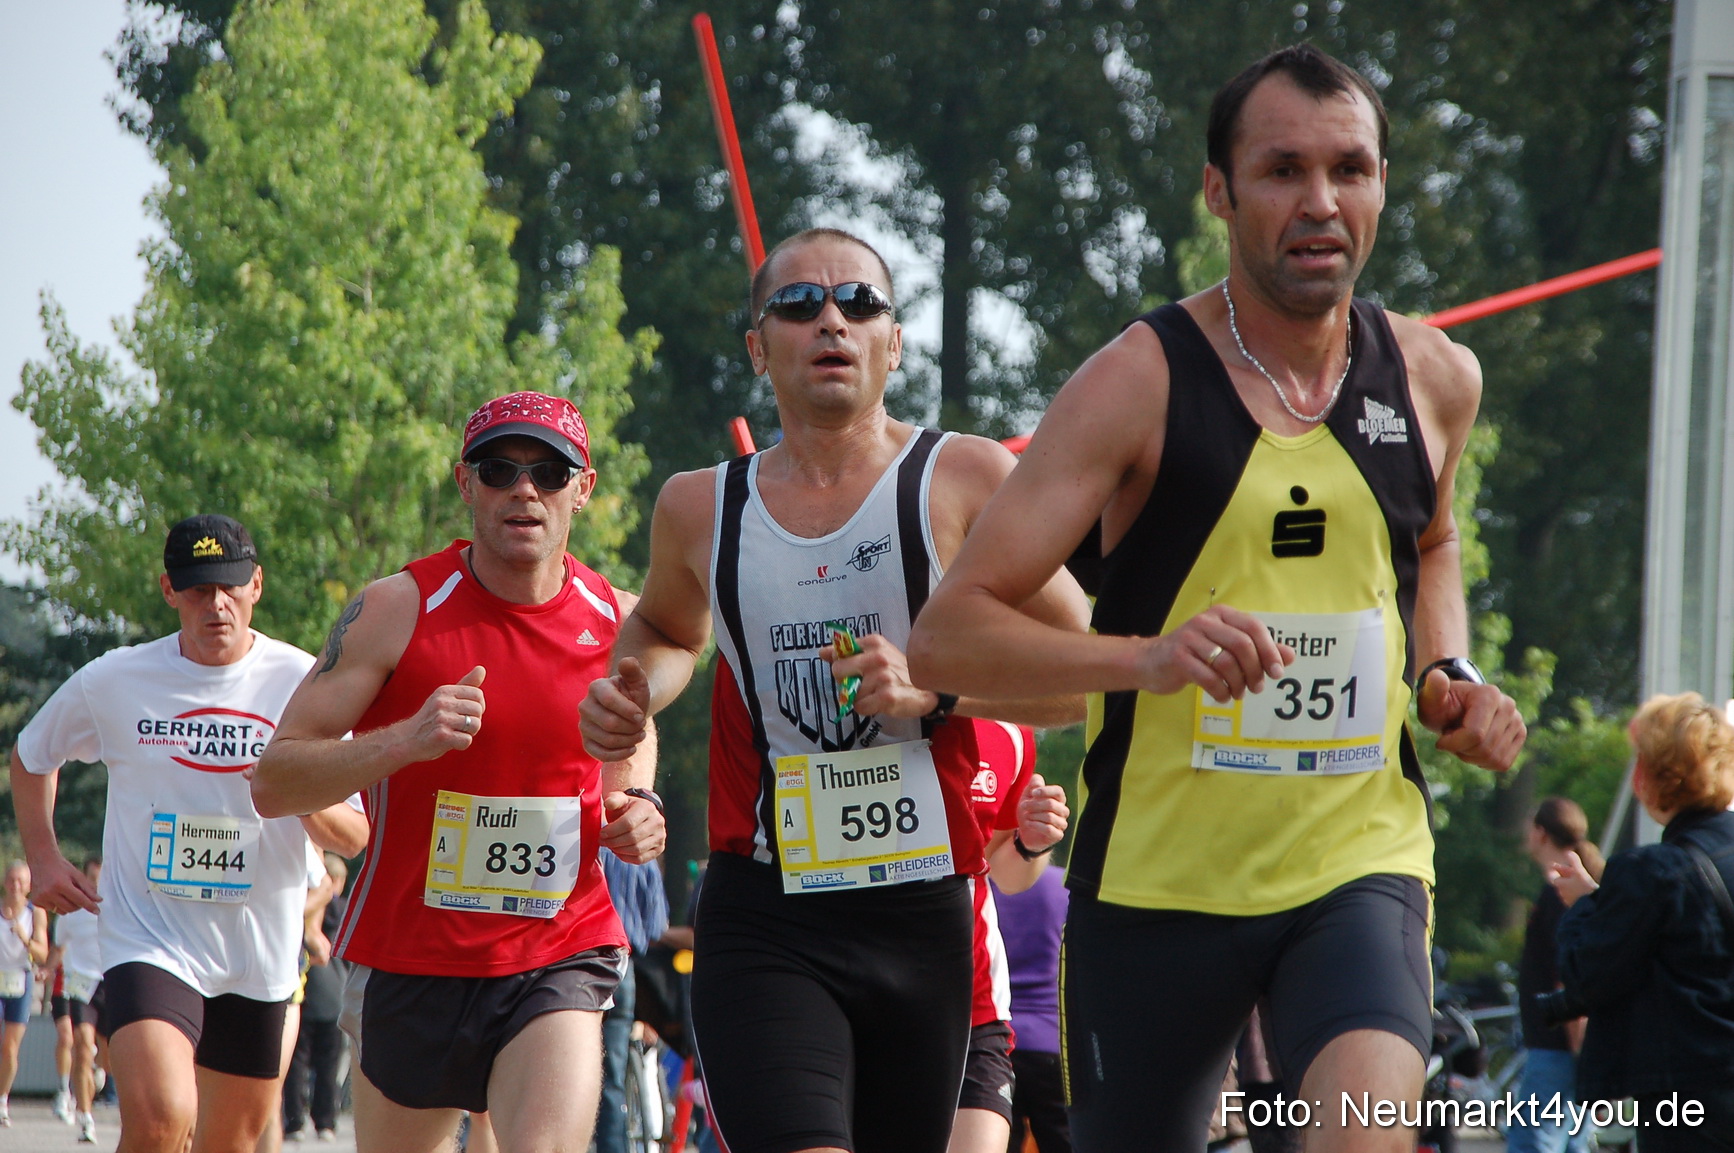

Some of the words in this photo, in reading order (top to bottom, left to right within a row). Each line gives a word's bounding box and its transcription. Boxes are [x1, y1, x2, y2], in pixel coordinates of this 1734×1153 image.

[797, 574, 848, 587] concurve
[770, 613, 882, 652] FORMEBAU
[1274, 675, 1358, 721] 351
[137, 719, 252, 739] GERHART
[138, 737, 188, 747] Autohaus
[1214, 750, 1268, 765] BOCK
[1320, 745, 1380, 763] PFLEIDERER
[816, 763, 900, 790] Thomas
[476, 805, 518, 828] Rudi
[784, 808, 794, 828] A
[841, 797, 920, 842] 598
[181, 822, 240, 841] Hermann
[155, 844, 163, 856] A
[437, 836, 446, 853] A
[181, 847, 246, 873] 3444
[485, 842, 556, 878] 833
[888, 854, 950, 874] PFLEIDERER
[801, 872, 845, 885] BOCK
[440, 894, 481, 906] BOCK
